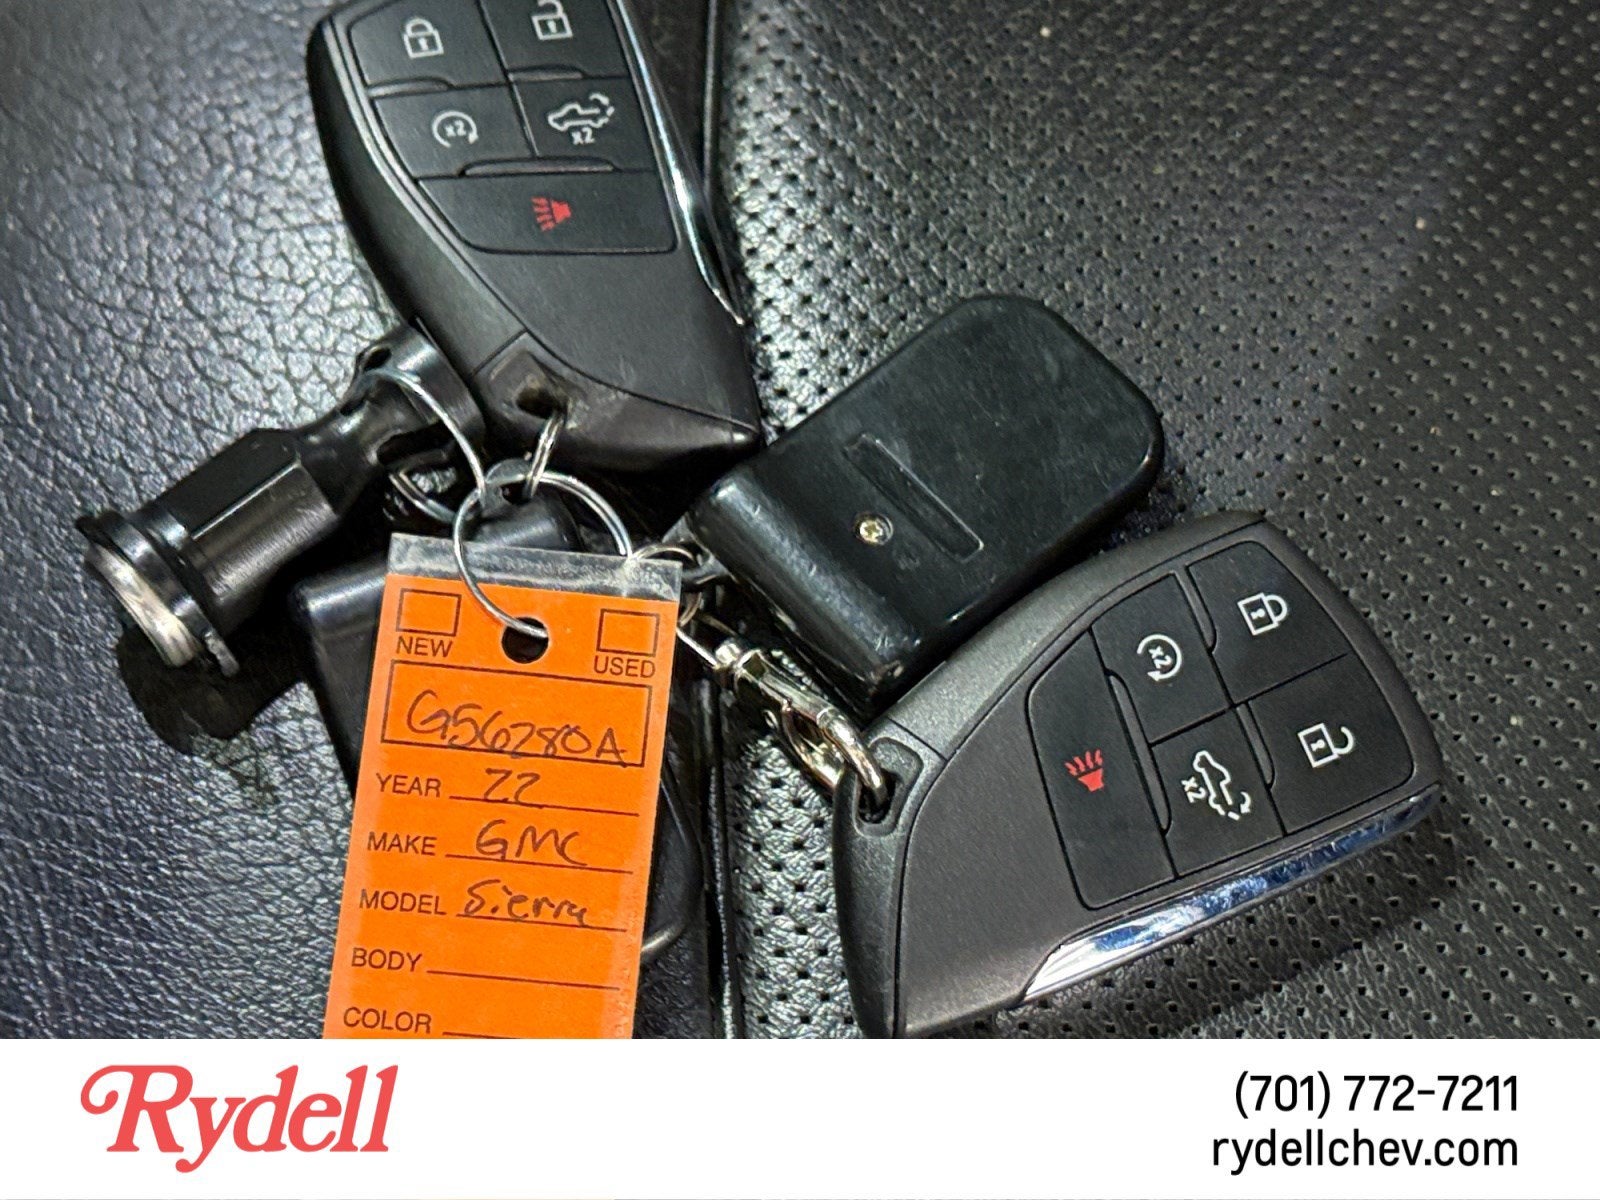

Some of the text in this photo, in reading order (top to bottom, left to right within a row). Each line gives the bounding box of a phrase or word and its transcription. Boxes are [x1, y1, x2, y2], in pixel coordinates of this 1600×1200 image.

[395, 636, 453, 658] NEW
[593, 655, 656, 679] USED
[376, 773, 441, 798] YEAR
[366, 831, 437, 856] MAKE
[475, 819, 588, 866] GMC
[359, 889, 446, 916] MODEL
[464, 879, 590, 927] Sierra
[351, 947, 422, 973] BODY
[343, 1007, 432, 1033] COLOR
